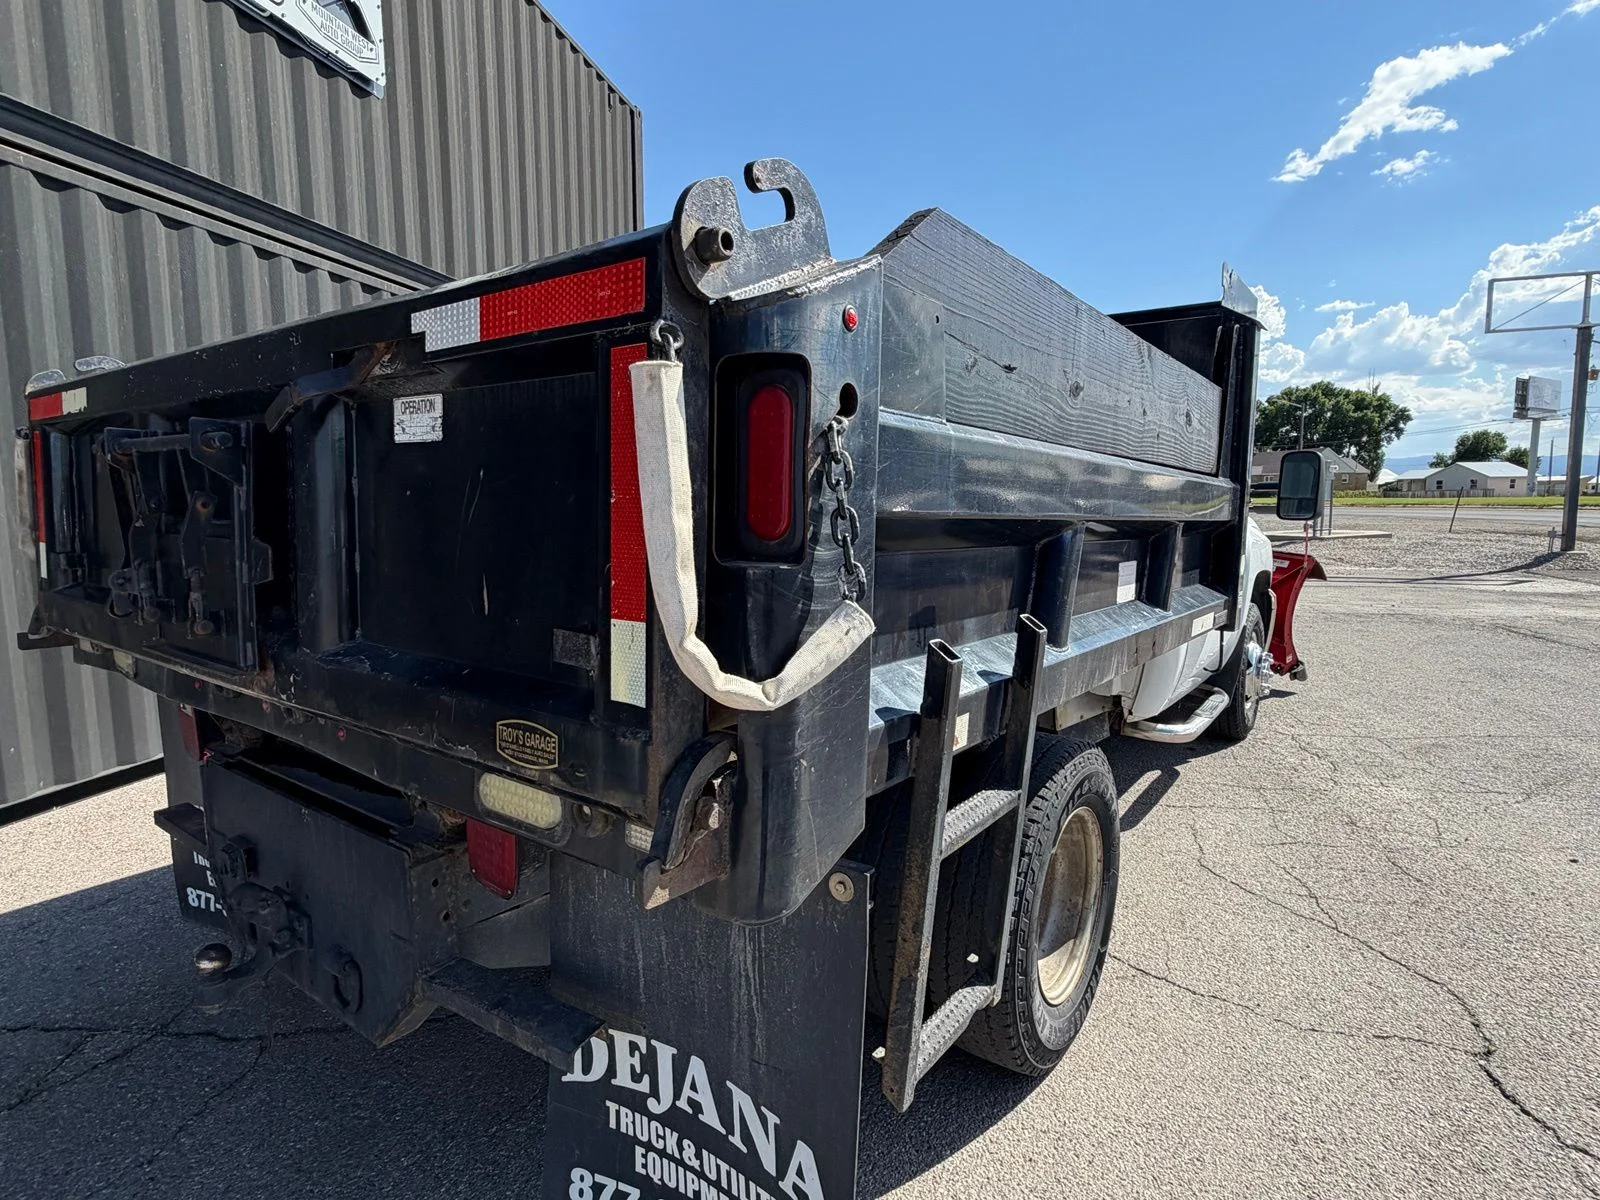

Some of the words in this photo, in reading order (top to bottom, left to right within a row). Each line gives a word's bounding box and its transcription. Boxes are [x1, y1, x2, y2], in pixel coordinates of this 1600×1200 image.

[311, 2, 350, 38] MOUNTAIN
[350, 30, 369, 51] WEST
[320, 20, 339, 40] AUTO
[340, 34, 364, 57] GROUP
[401, 398, 436, 415] OPERATION
[499, 725, 524, 745] TROY'S
[524, 732, 556, 753] GARAGE
[561, 1028, 825, 1200] DEJANA
[568, 1167, 664, 1200] 877
[634, 1145, 731, 1200] EQUIPM
